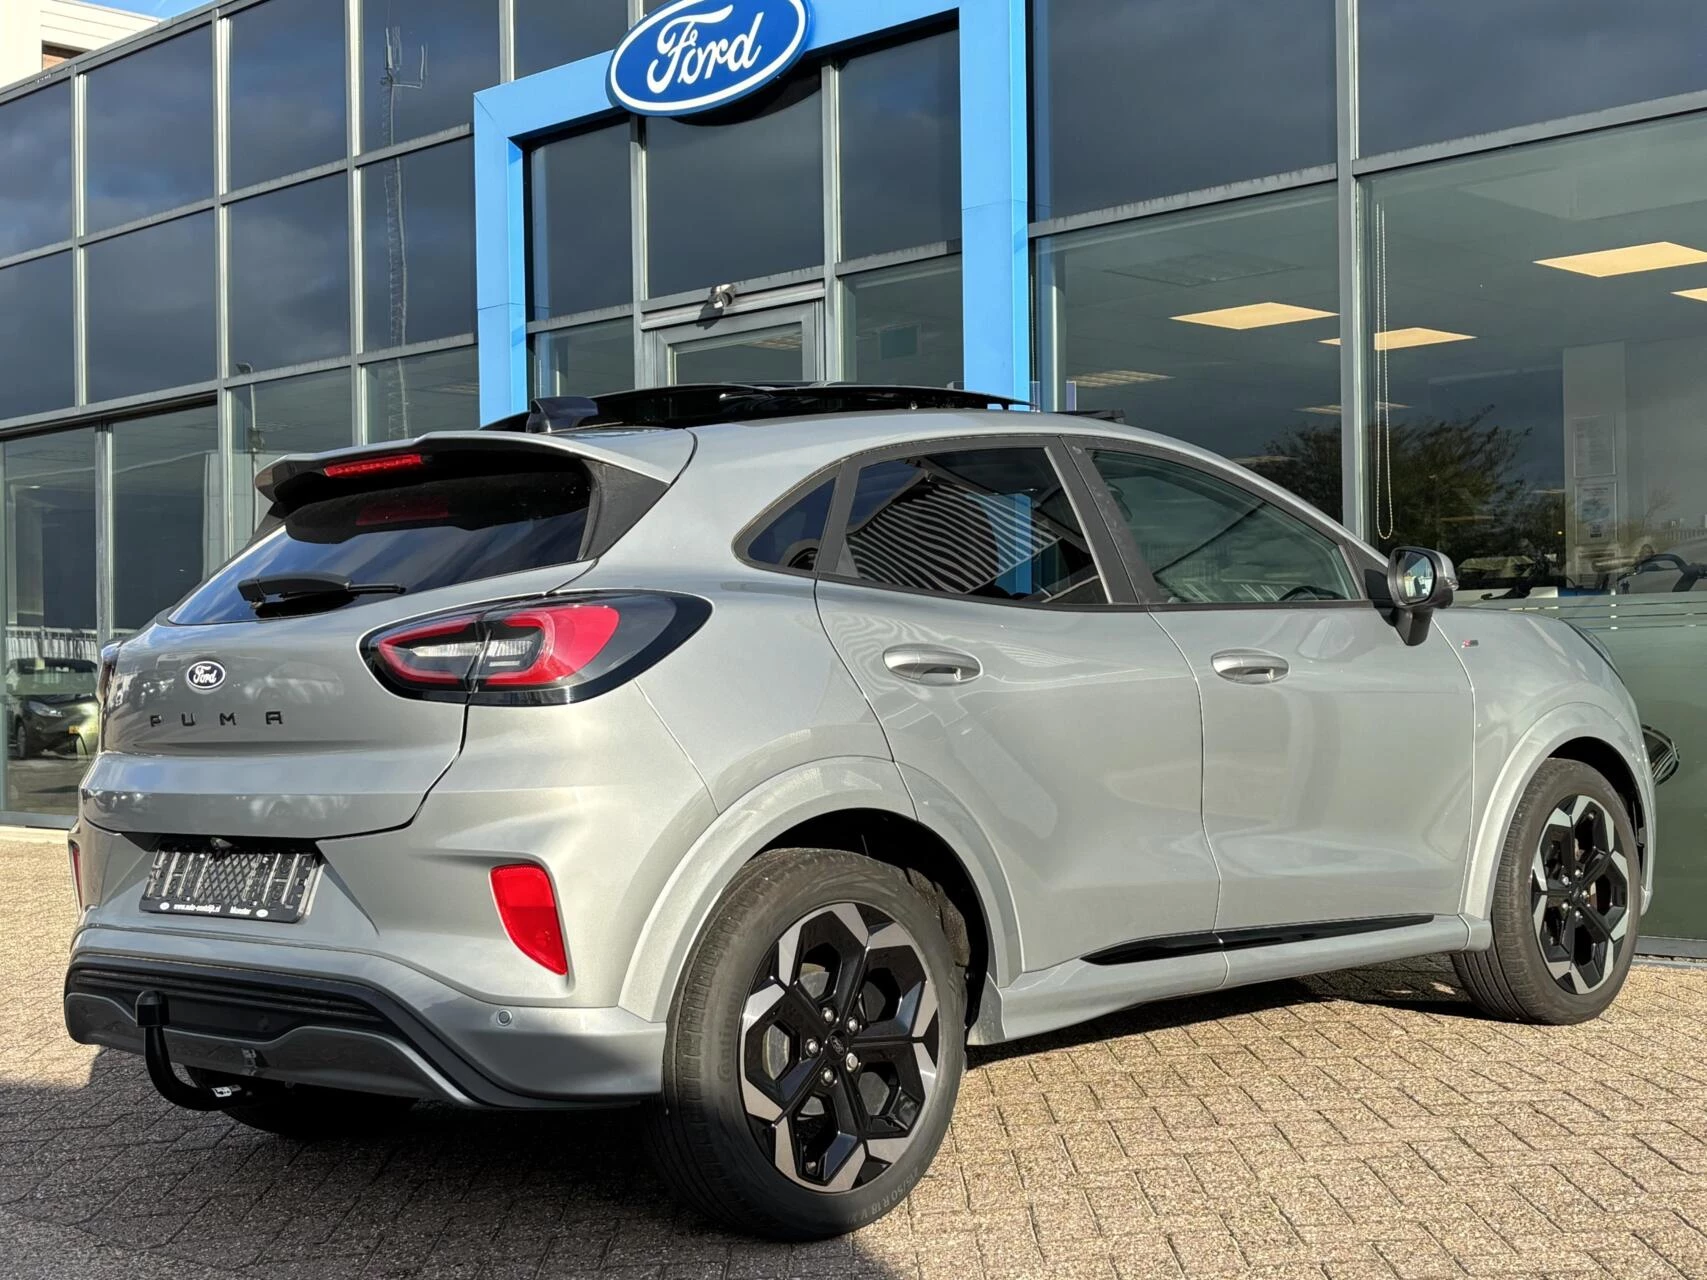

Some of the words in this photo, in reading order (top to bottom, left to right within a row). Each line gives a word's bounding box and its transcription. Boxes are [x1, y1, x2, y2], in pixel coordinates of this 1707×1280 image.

[647, 5, 764, 93] Ford
[193, 665, 217, 684] Ford
[150, 710, 283, 727] PUMA
[717, 985, 740, 1083] Continen
